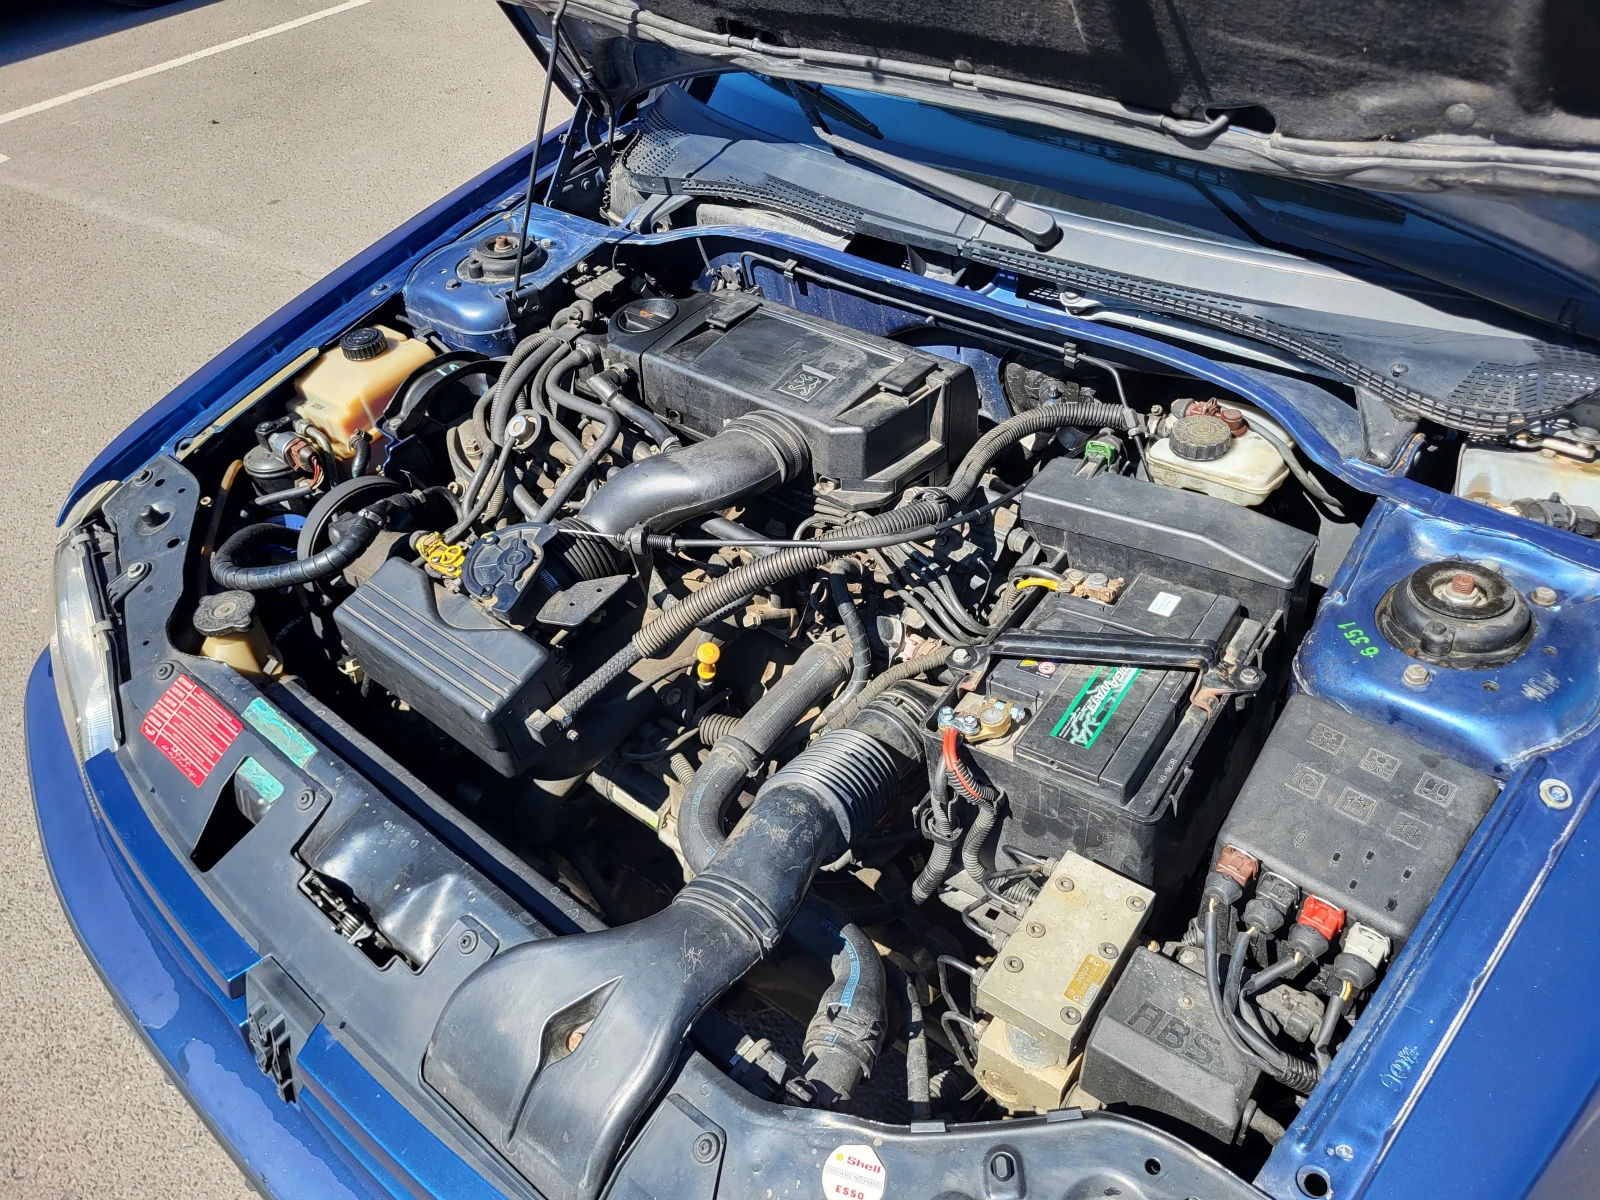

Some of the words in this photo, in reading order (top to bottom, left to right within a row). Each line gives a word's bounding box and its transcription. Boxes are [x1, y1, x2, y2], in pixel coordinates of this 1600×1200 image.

[1337, 621, 1379, 656] 6351
[1084, 662, 1131, 716] GIGAWATT
[1126, 1000, 1222, 1066] ABS
[846, 1156, 881, 1174] Shell
[835, 1184, 864, 1200] ESSO
